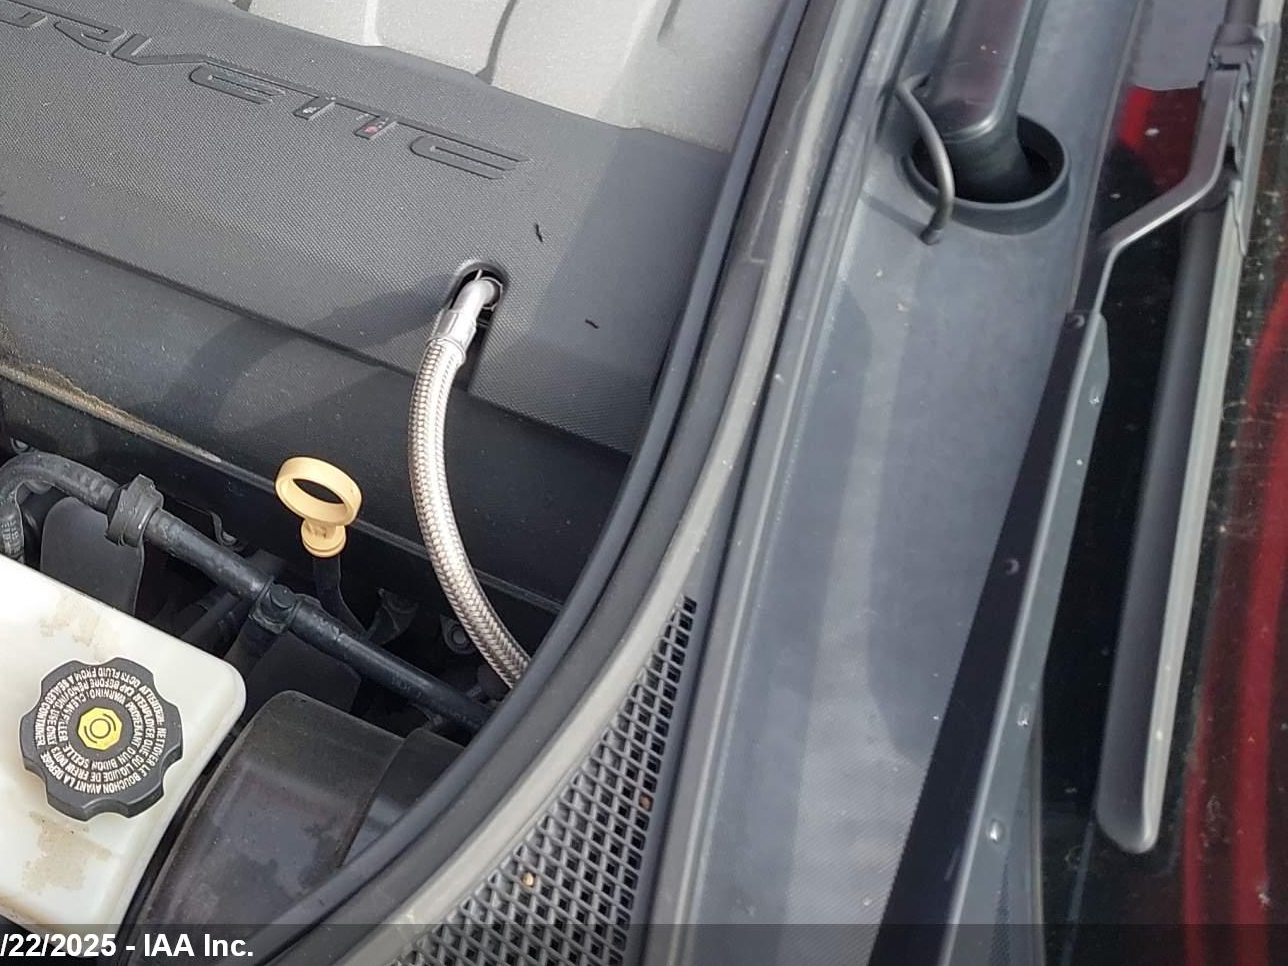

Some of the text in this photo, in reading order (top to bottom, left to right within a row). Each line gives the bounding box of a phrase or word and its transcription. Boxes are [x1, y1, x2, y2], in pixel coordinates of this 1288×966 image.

[65, 673, 76, 685] A
[72, 666, 96, 682] FROM
[96, 666, 121, 679] FLUID
[42, 677, 70, 705] SEALED
[88, 677, 121, 690] BEFORE
[118, 681, 136, 697] CAP
[61, 691, 87, 716] CLEAN
[46, 707, 61, 726] USE
[50, 744, 71, 767] DOT3
[137, 738, 155, 758] QUE
[145, 727, 167, 768] NETTOYER
[89, 758, 119, 772] BIDON
[130, 753, 146, 769] DU
[63, 760, 90, 781] FREIN
[89, 770, 101, 783] DE
[102, 762, 136, 783] LIQUIDE
[137, 763, 153, 778] LE
[60, 772, 76, 787] LA
[73, 778, 101, 794] AVANT
[102, 771, 143, 794] BOUCHON
